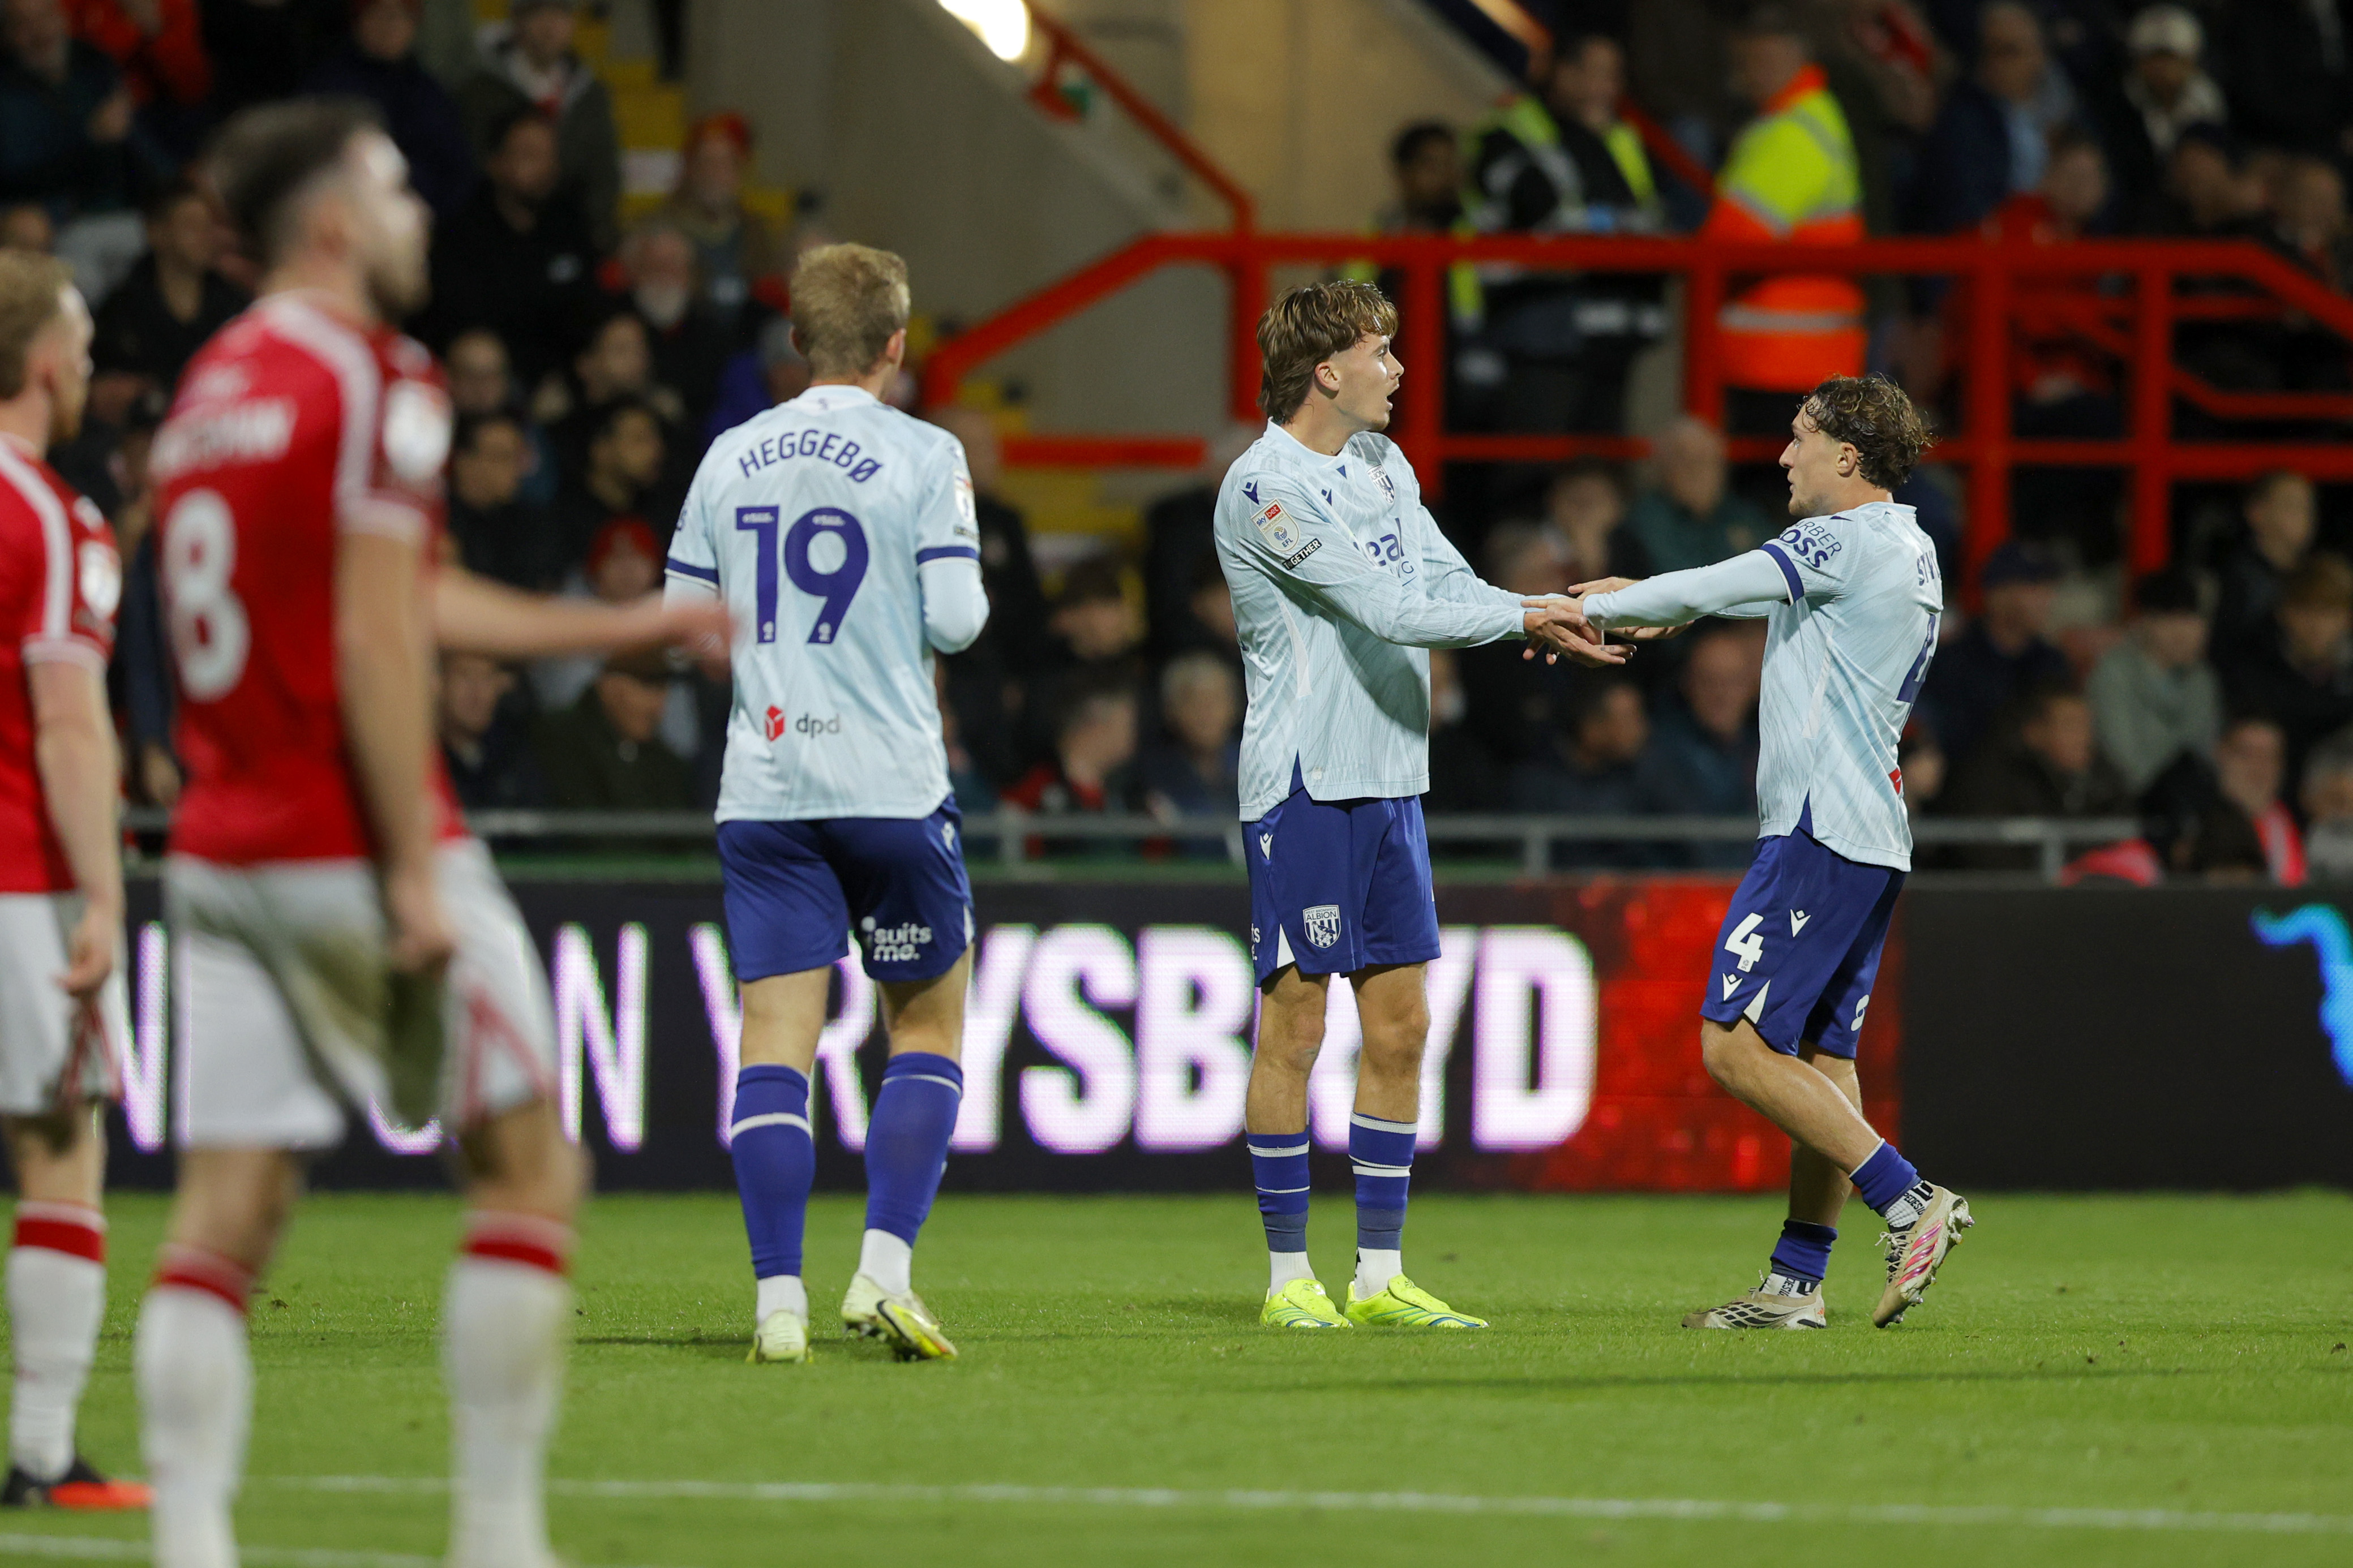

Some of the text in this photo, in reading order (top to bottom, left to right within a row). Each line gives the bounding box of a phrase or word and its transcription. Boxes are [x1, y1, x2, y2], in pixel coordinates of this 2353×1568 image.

[739, 429, 882, 483] HEGGEBØ
[1257, 505, 1279, 526] sky bet
[1281, 538, 1294, 548] EFL
[1353, 517, 1405, 566] eal
[736, 505, 868, 644] 19
[164, 488, 251, 702] 8
[796, 712, 841, 740] dpd
[874, 922, 933, 944] suits
[1306, 910, 1337, 921] ALBION
[1724, 912, 1764, 973] 4
